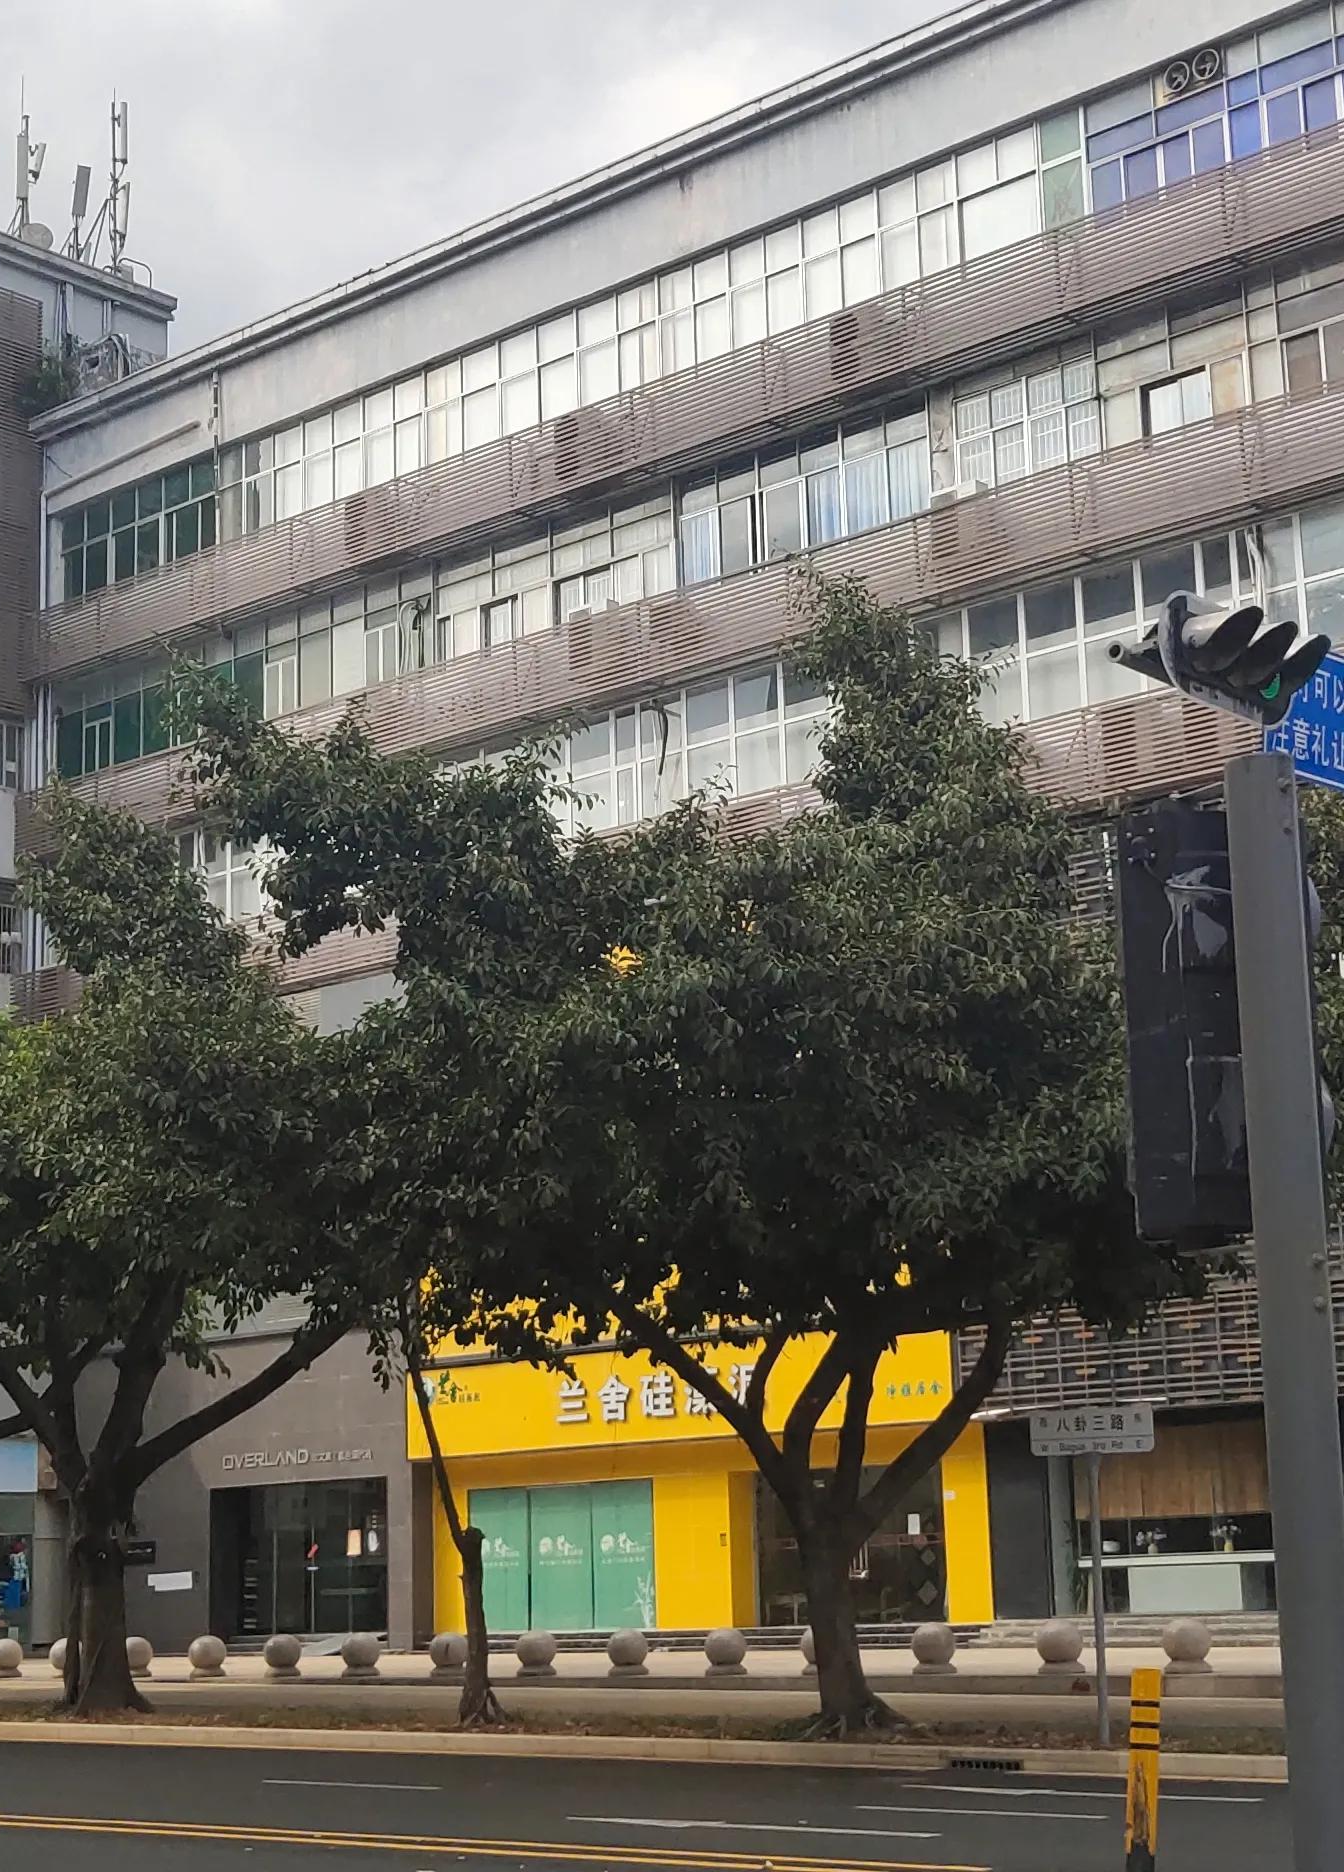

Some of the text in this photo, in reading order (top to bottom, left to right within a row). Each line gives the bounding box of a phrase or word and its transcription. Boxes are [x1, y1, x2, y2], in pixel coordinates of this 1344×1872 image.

[1056, 1413, 1124, 1432] 八卦三路
[222, 1448, 308, 1470] OVERLAND
